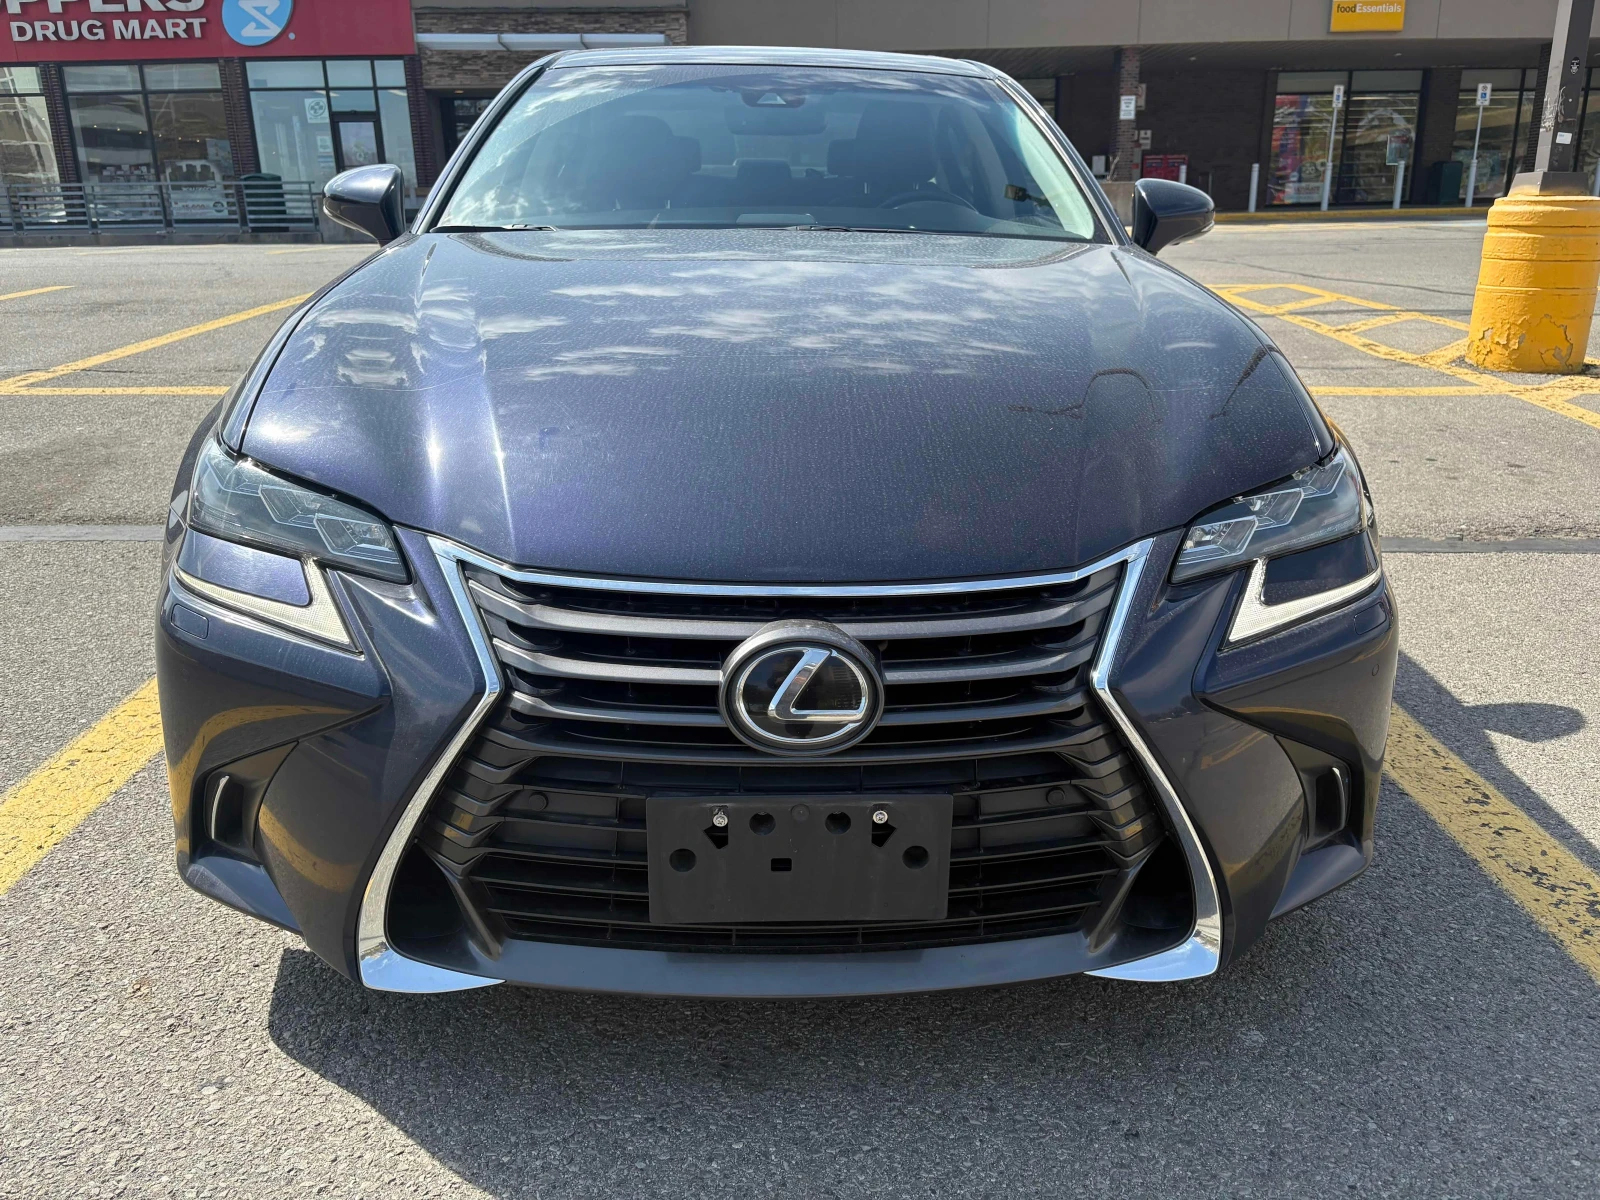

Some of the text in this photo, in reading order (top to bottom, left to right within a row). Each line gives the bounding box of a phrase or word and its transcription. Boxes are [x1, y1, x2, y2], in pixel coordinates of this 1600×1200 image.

[1336, 3, 1402, 14] foodEssentials
[10, 18, 207, 42] DRUG MART
